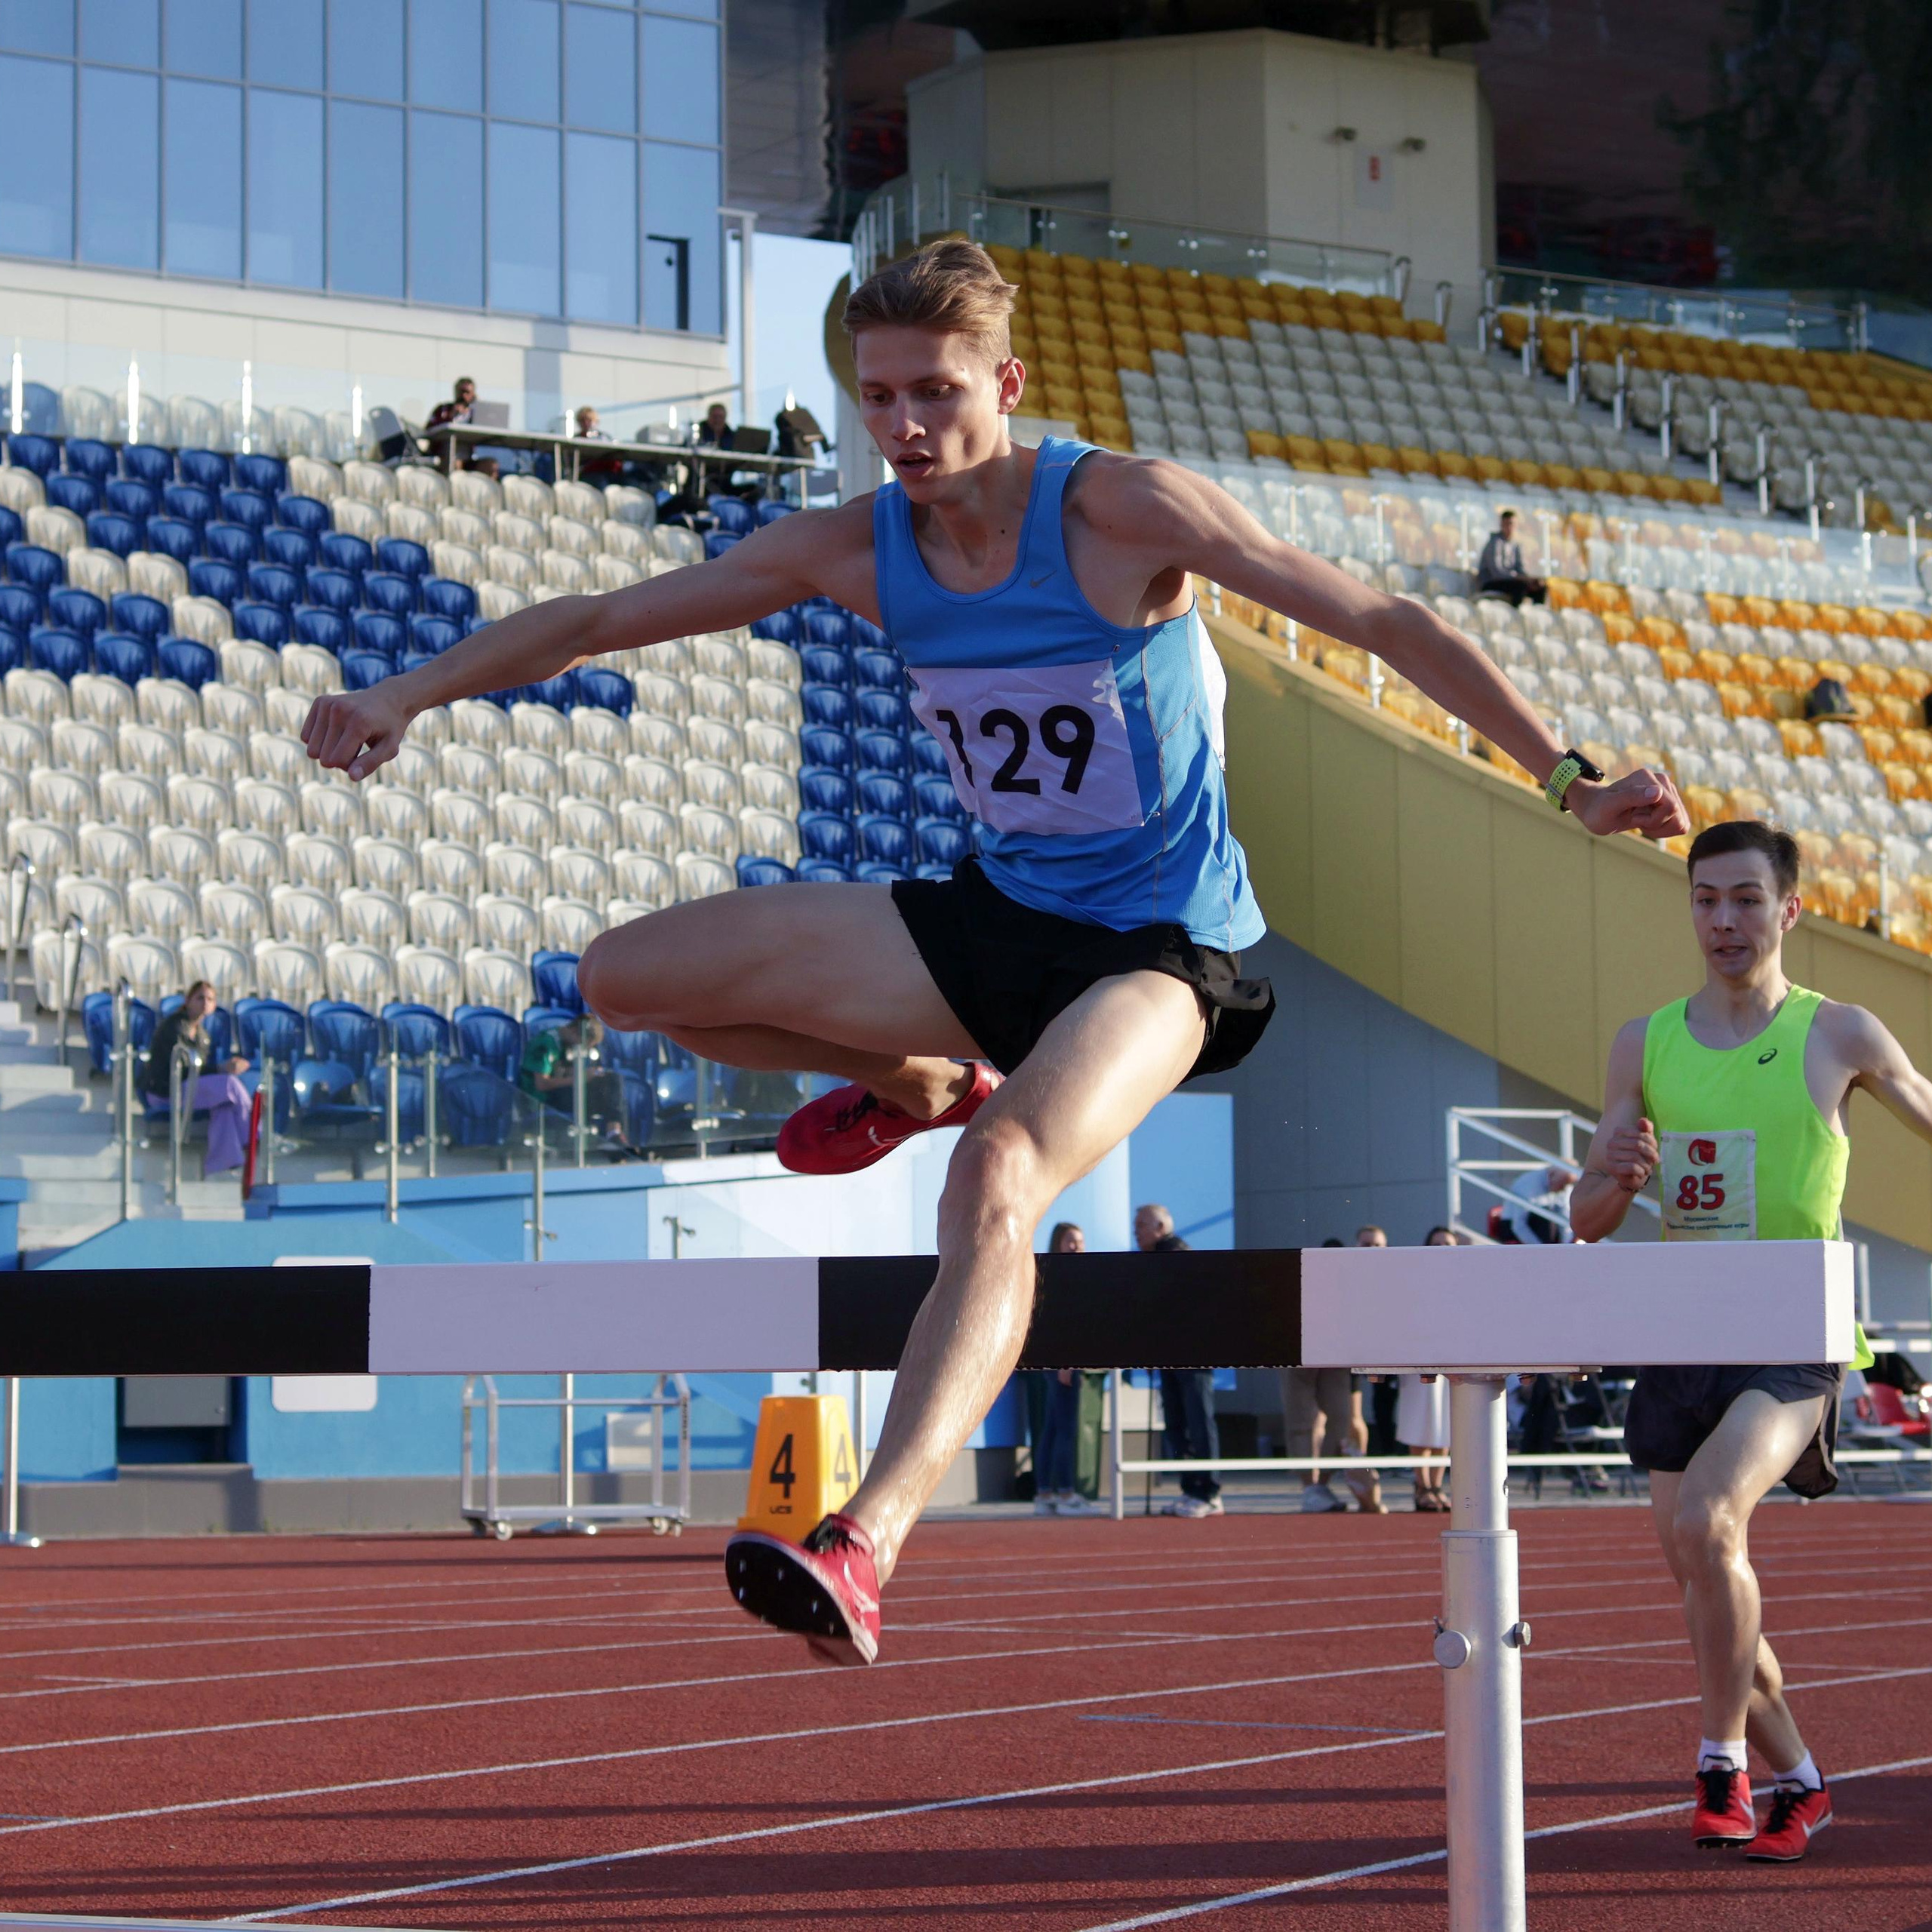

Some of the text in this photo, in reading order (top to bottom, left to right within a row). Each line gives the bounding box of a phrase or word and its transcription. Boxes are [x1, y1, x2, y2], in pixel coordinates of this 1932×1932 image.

[936, 705, 1095, 795] 129
[1676, 1174, 1725, 1211] 85
[770, 1433, 796, 1499] 4
[835, 1433, 851, 1497] 4
